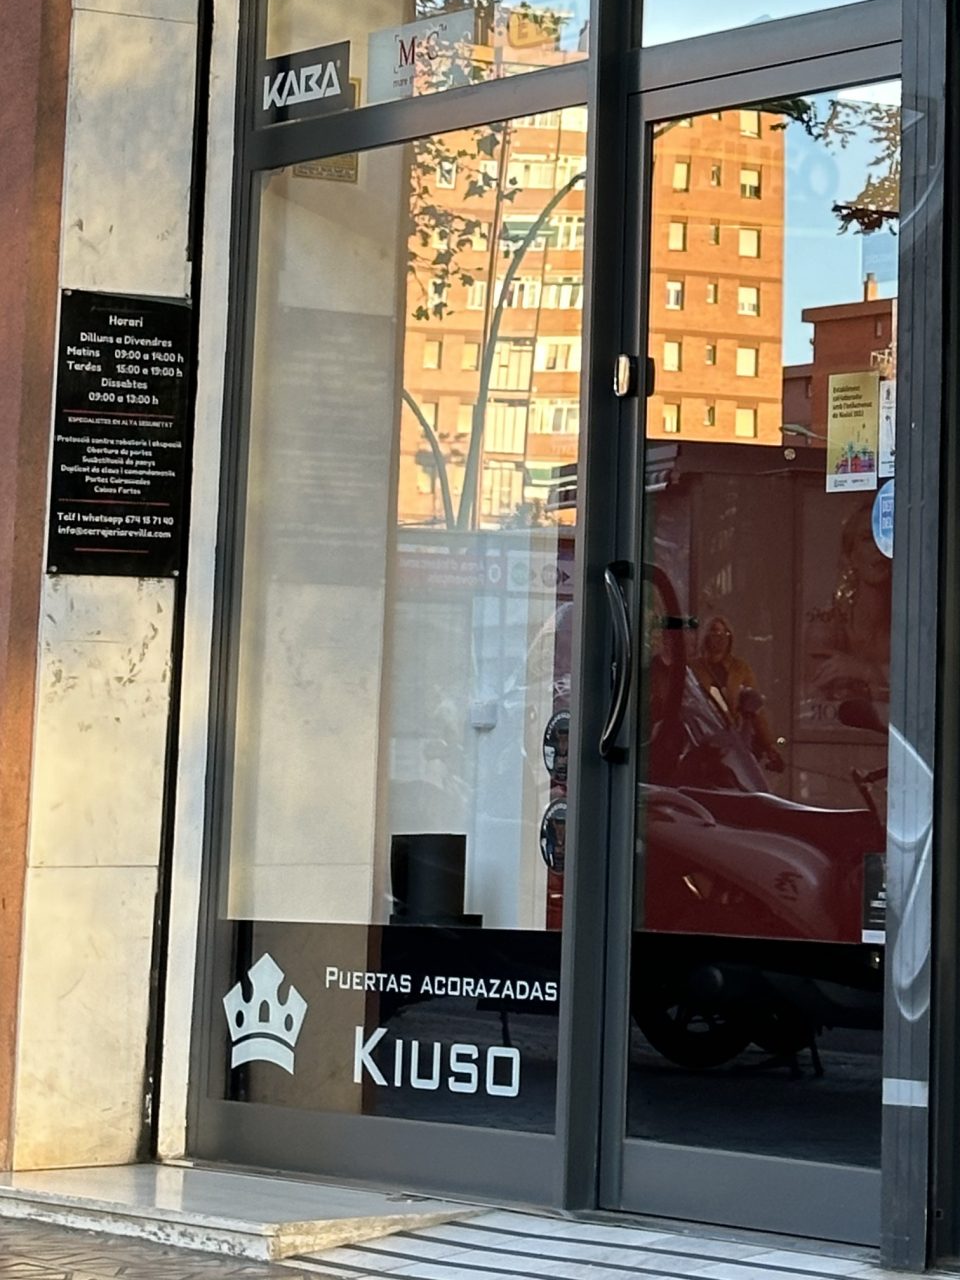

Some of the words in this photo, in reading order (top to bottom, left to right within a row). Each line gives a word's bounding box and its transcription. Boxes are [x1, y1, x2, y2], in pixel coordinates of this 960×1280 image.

[263, 61, 341, 110] KABA
[109, 315, 144, 327] Horari
[80, 332, 114, 344] Dilluns
[124, 335, 172, 347] Divendres
[66, 346, 101, 358] Matins
[114, 349, 141, 360] 09:00
[177, 353, 184, 363] h
[67, 360, 102, 372] Tardes
[101, 378, 148, 390] Dissabtes
[152, 395, 159, 405] h
[82, 513, 124, 524] whatsapp
[125, 515, 141, 524] 674
[152, 516, 162, 525] 71
[420, 976, 558, 1002] ACORAZADAS
